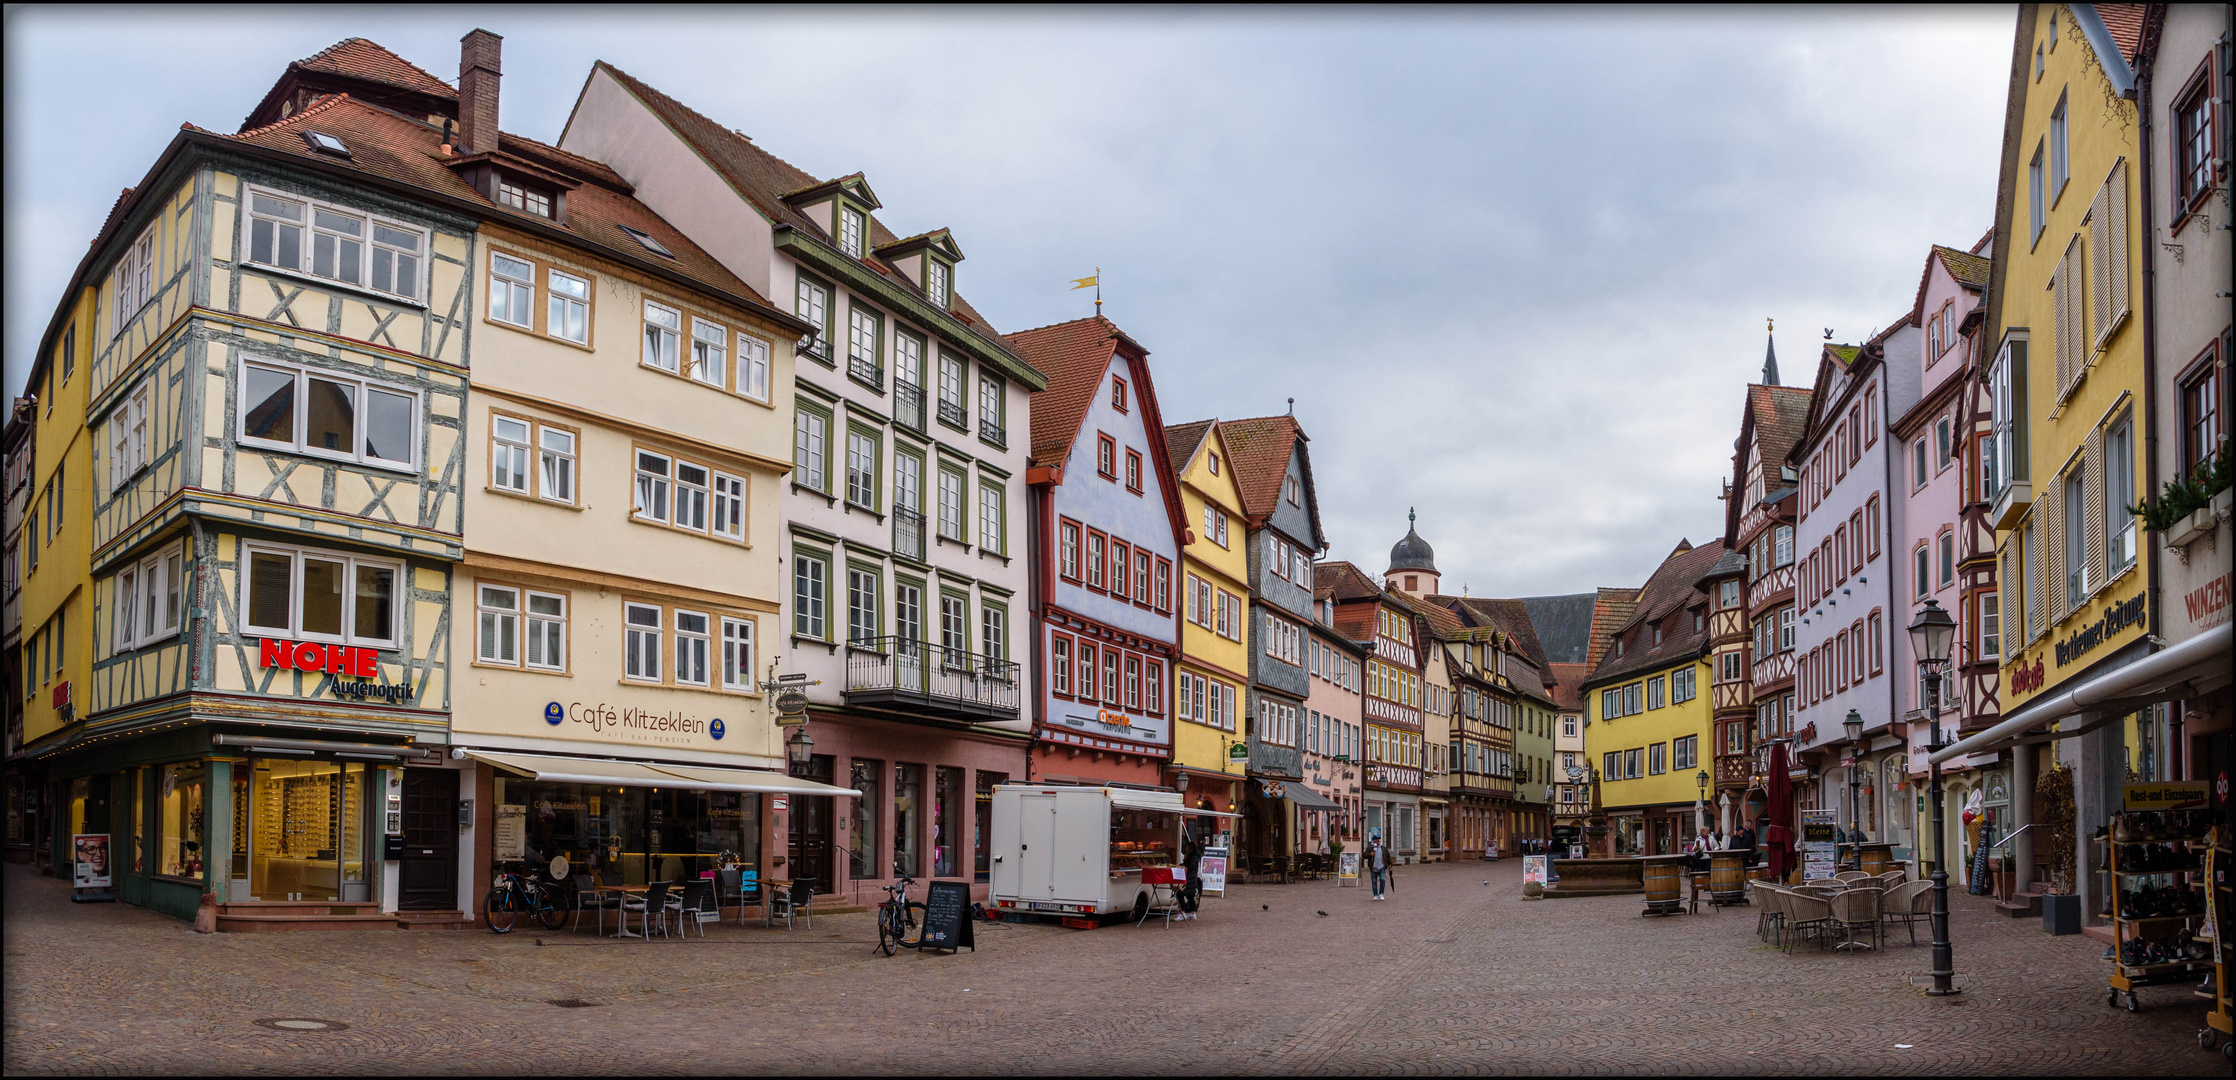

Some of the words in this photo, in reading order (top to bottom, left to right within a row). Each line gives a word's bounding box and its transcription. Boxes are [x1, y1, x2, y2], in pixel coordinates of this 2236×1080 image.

[2184, 571, 2233, 623] WINZEN
[2055, 618, 2105, 669] Wertheimer
[2103, 590, 2146, 639] Zeitung
[258, 638, 378, 677] NOHE
[329, 674, 414, 702] Augenoptik
[569, 702, 617, 732] Café
[623, 706, 704, 734] Klitzeklein
[2164, 788, 2205, 803] Einzelpaare
